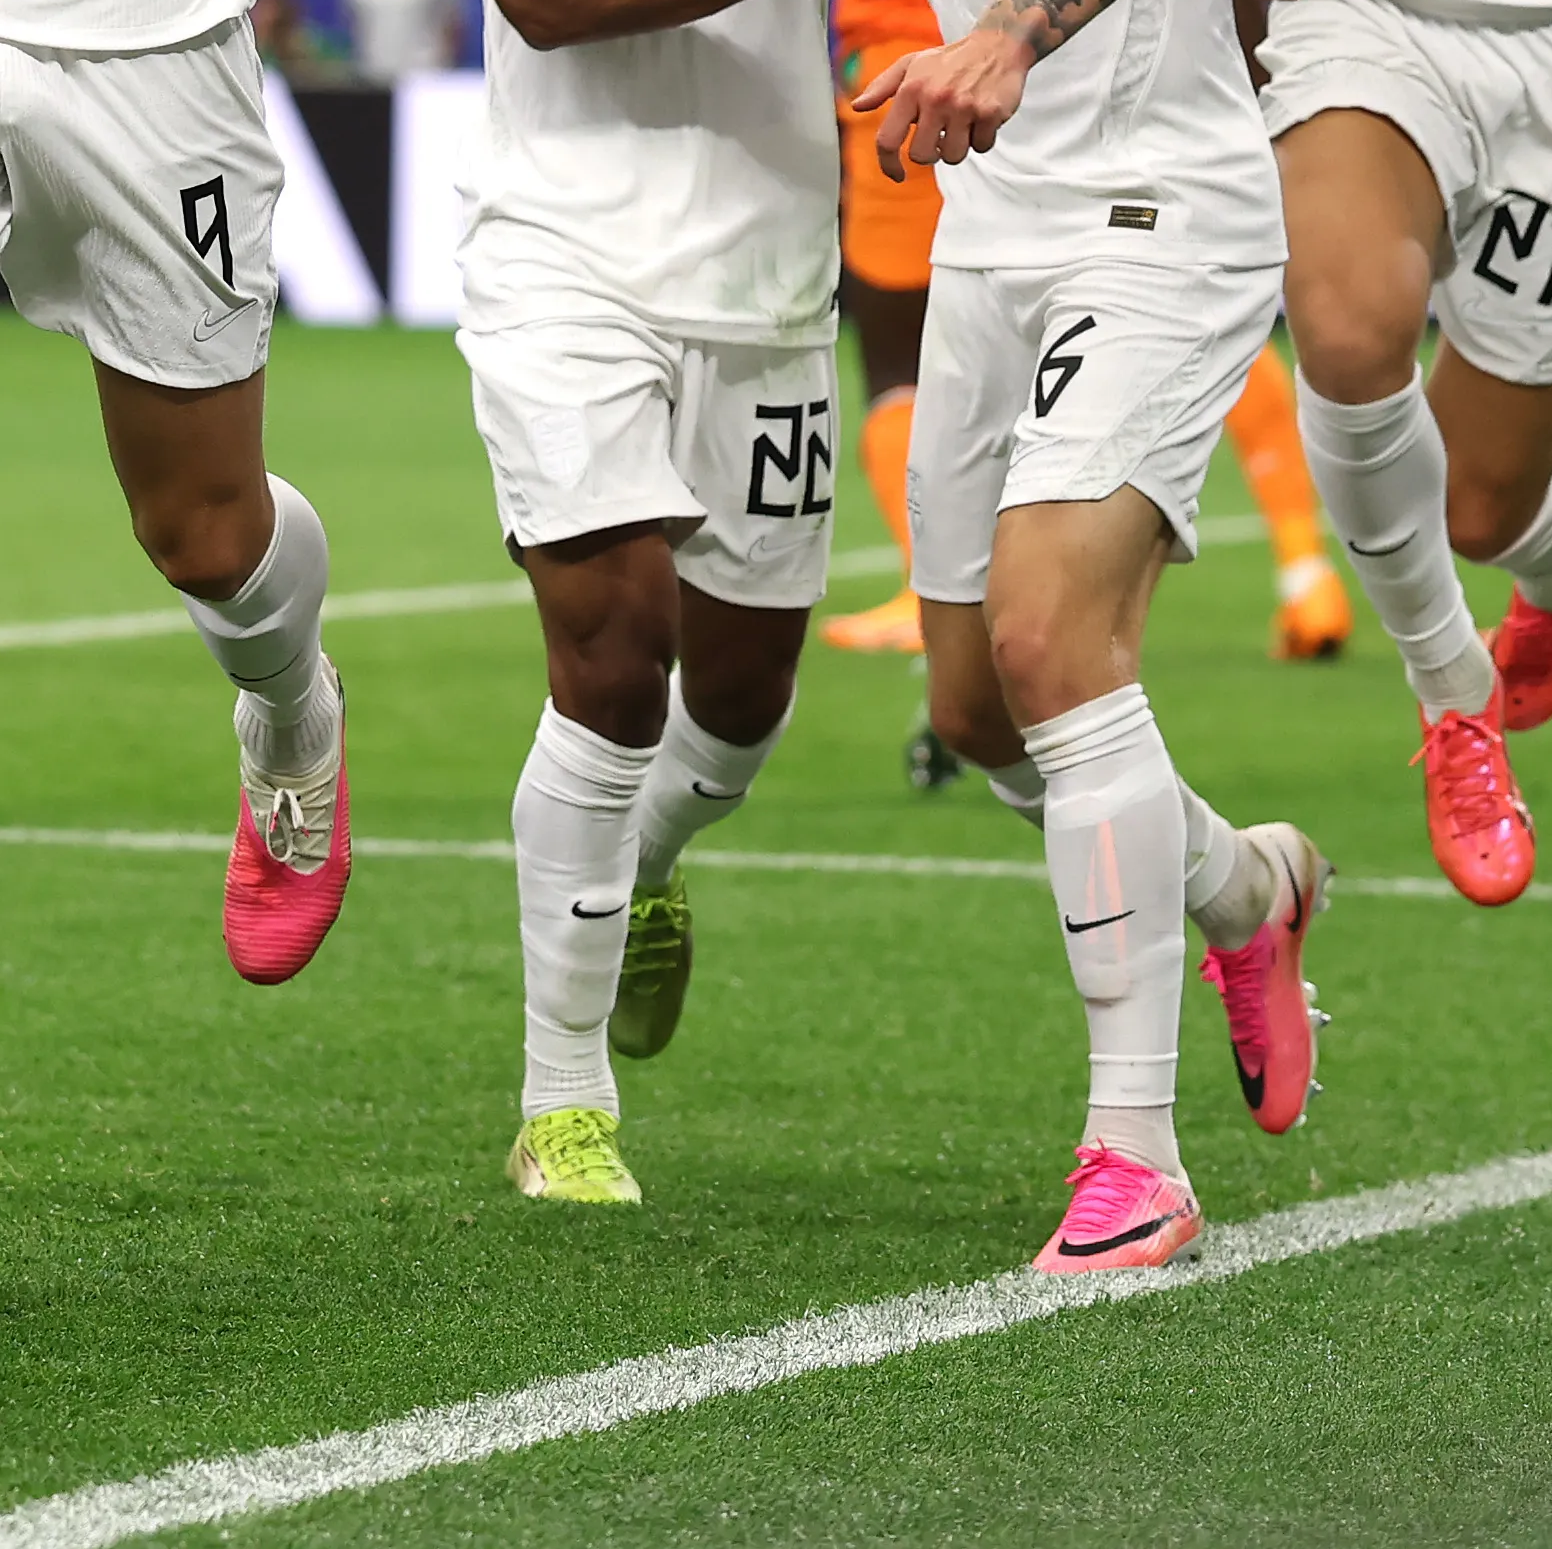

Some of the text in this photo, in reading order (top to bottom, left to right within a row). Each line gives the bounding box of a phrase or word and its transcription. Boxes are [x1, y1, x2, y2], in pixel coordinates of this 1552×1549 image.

[179, 174, 236, 292] 9
[1035, 314, 1097, 419] 6
[746, 397, 832, 518] 22
